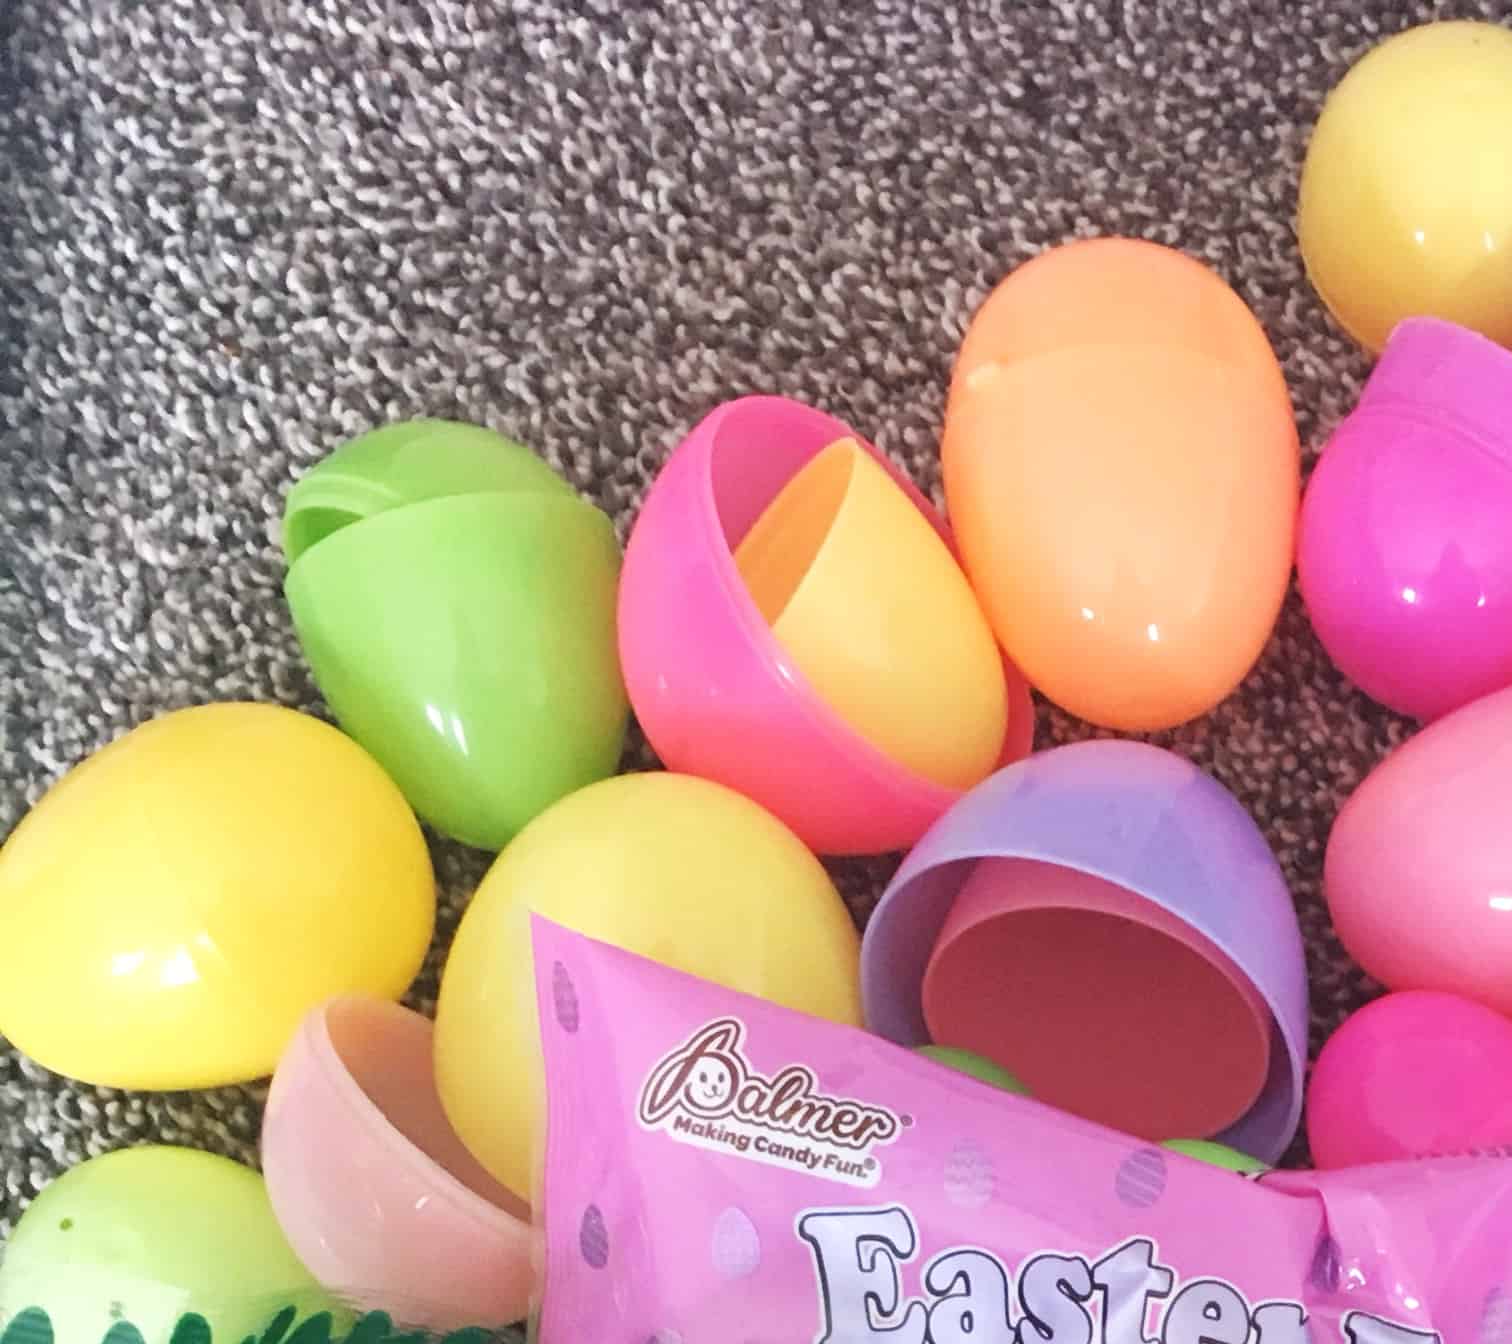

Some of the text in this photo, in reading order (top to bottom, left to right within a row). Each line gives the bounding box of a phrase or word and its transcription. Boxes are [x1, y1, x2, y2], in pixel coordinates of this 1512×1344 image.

[641, 1020, 896, 1149] Palmer
[673, 1115, 751, 1150] Making
[754, 1136, 822, 1169] Candy
